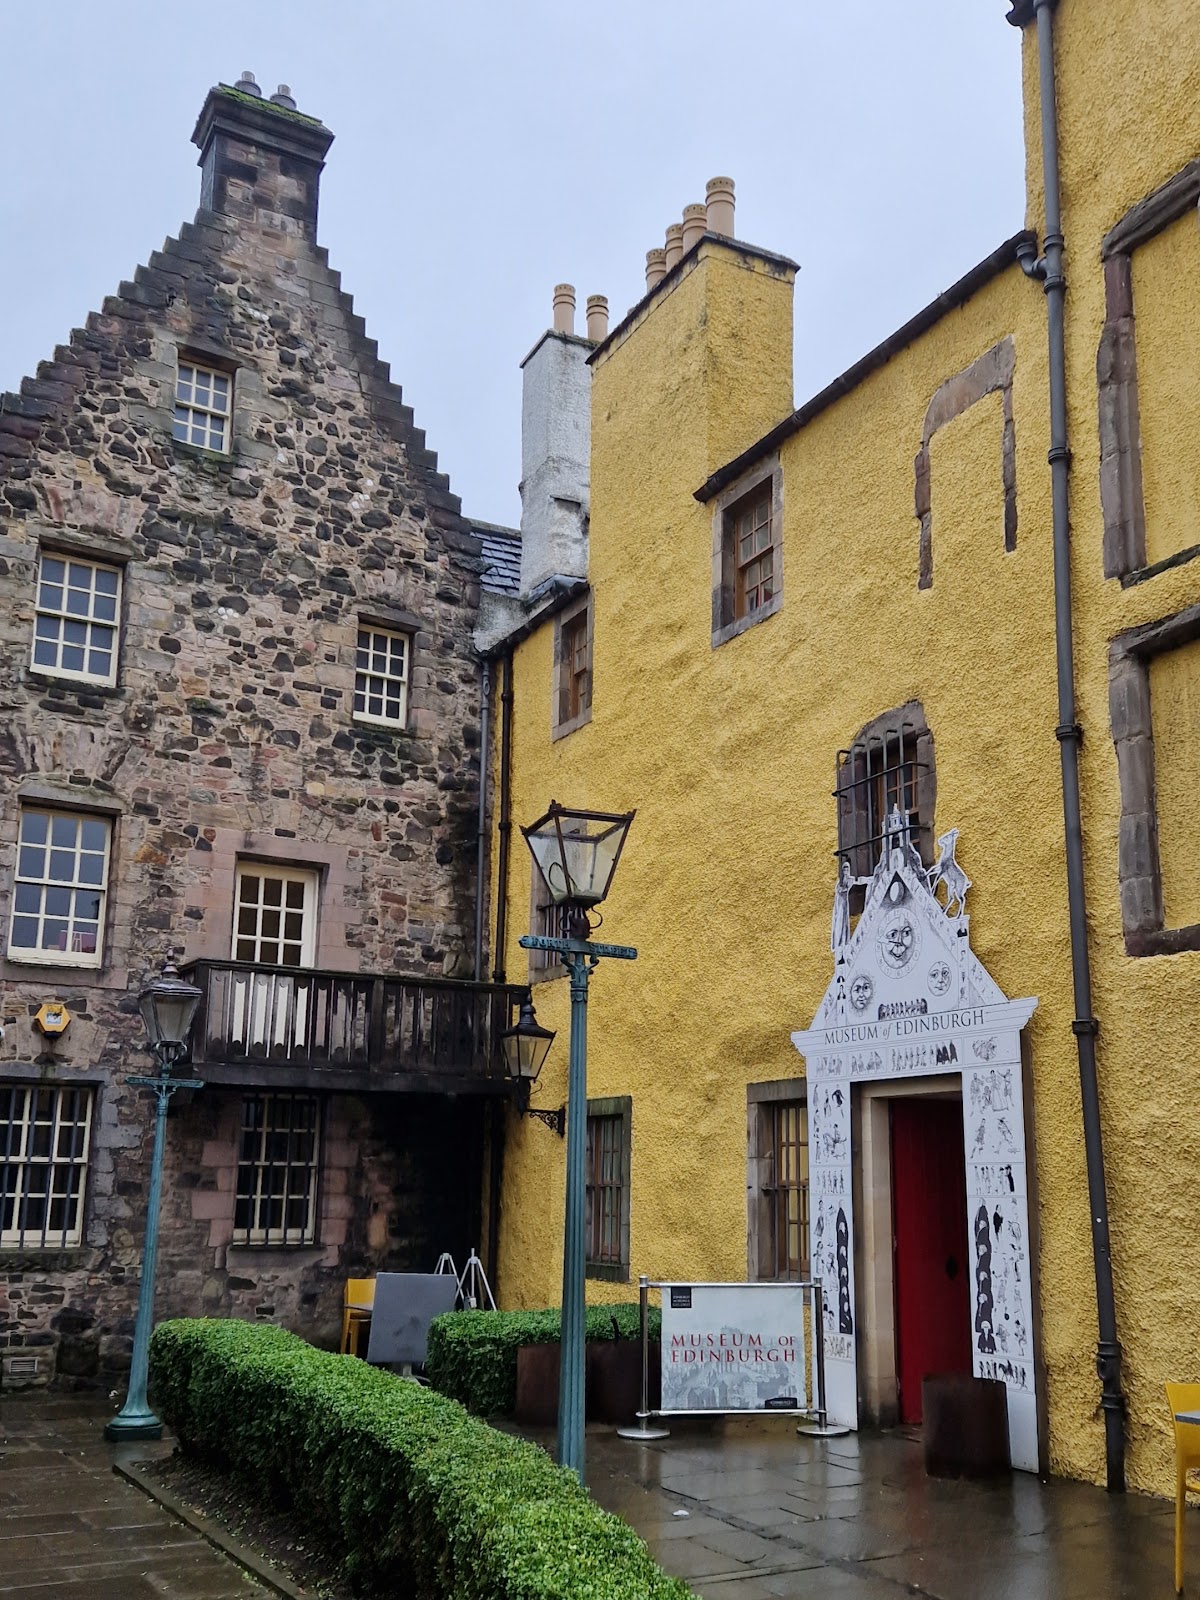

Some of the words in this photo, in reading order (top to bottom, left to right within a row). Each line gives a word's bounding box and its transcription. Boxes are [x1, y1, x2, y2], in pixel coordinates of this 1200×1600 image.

[531, 937, 571, 950] FORTH
[824, 1026, 878, 1045] MUSEUM
[882, 1022, 893, 1041] of
[896, 1009, 985, 1036] EDINBURGH
[671, 1333, 762, 1347] MUSEUM
[778, 1335, 796, 1347] OF
[671, 1348, 796, 1363] EDINBURGH
